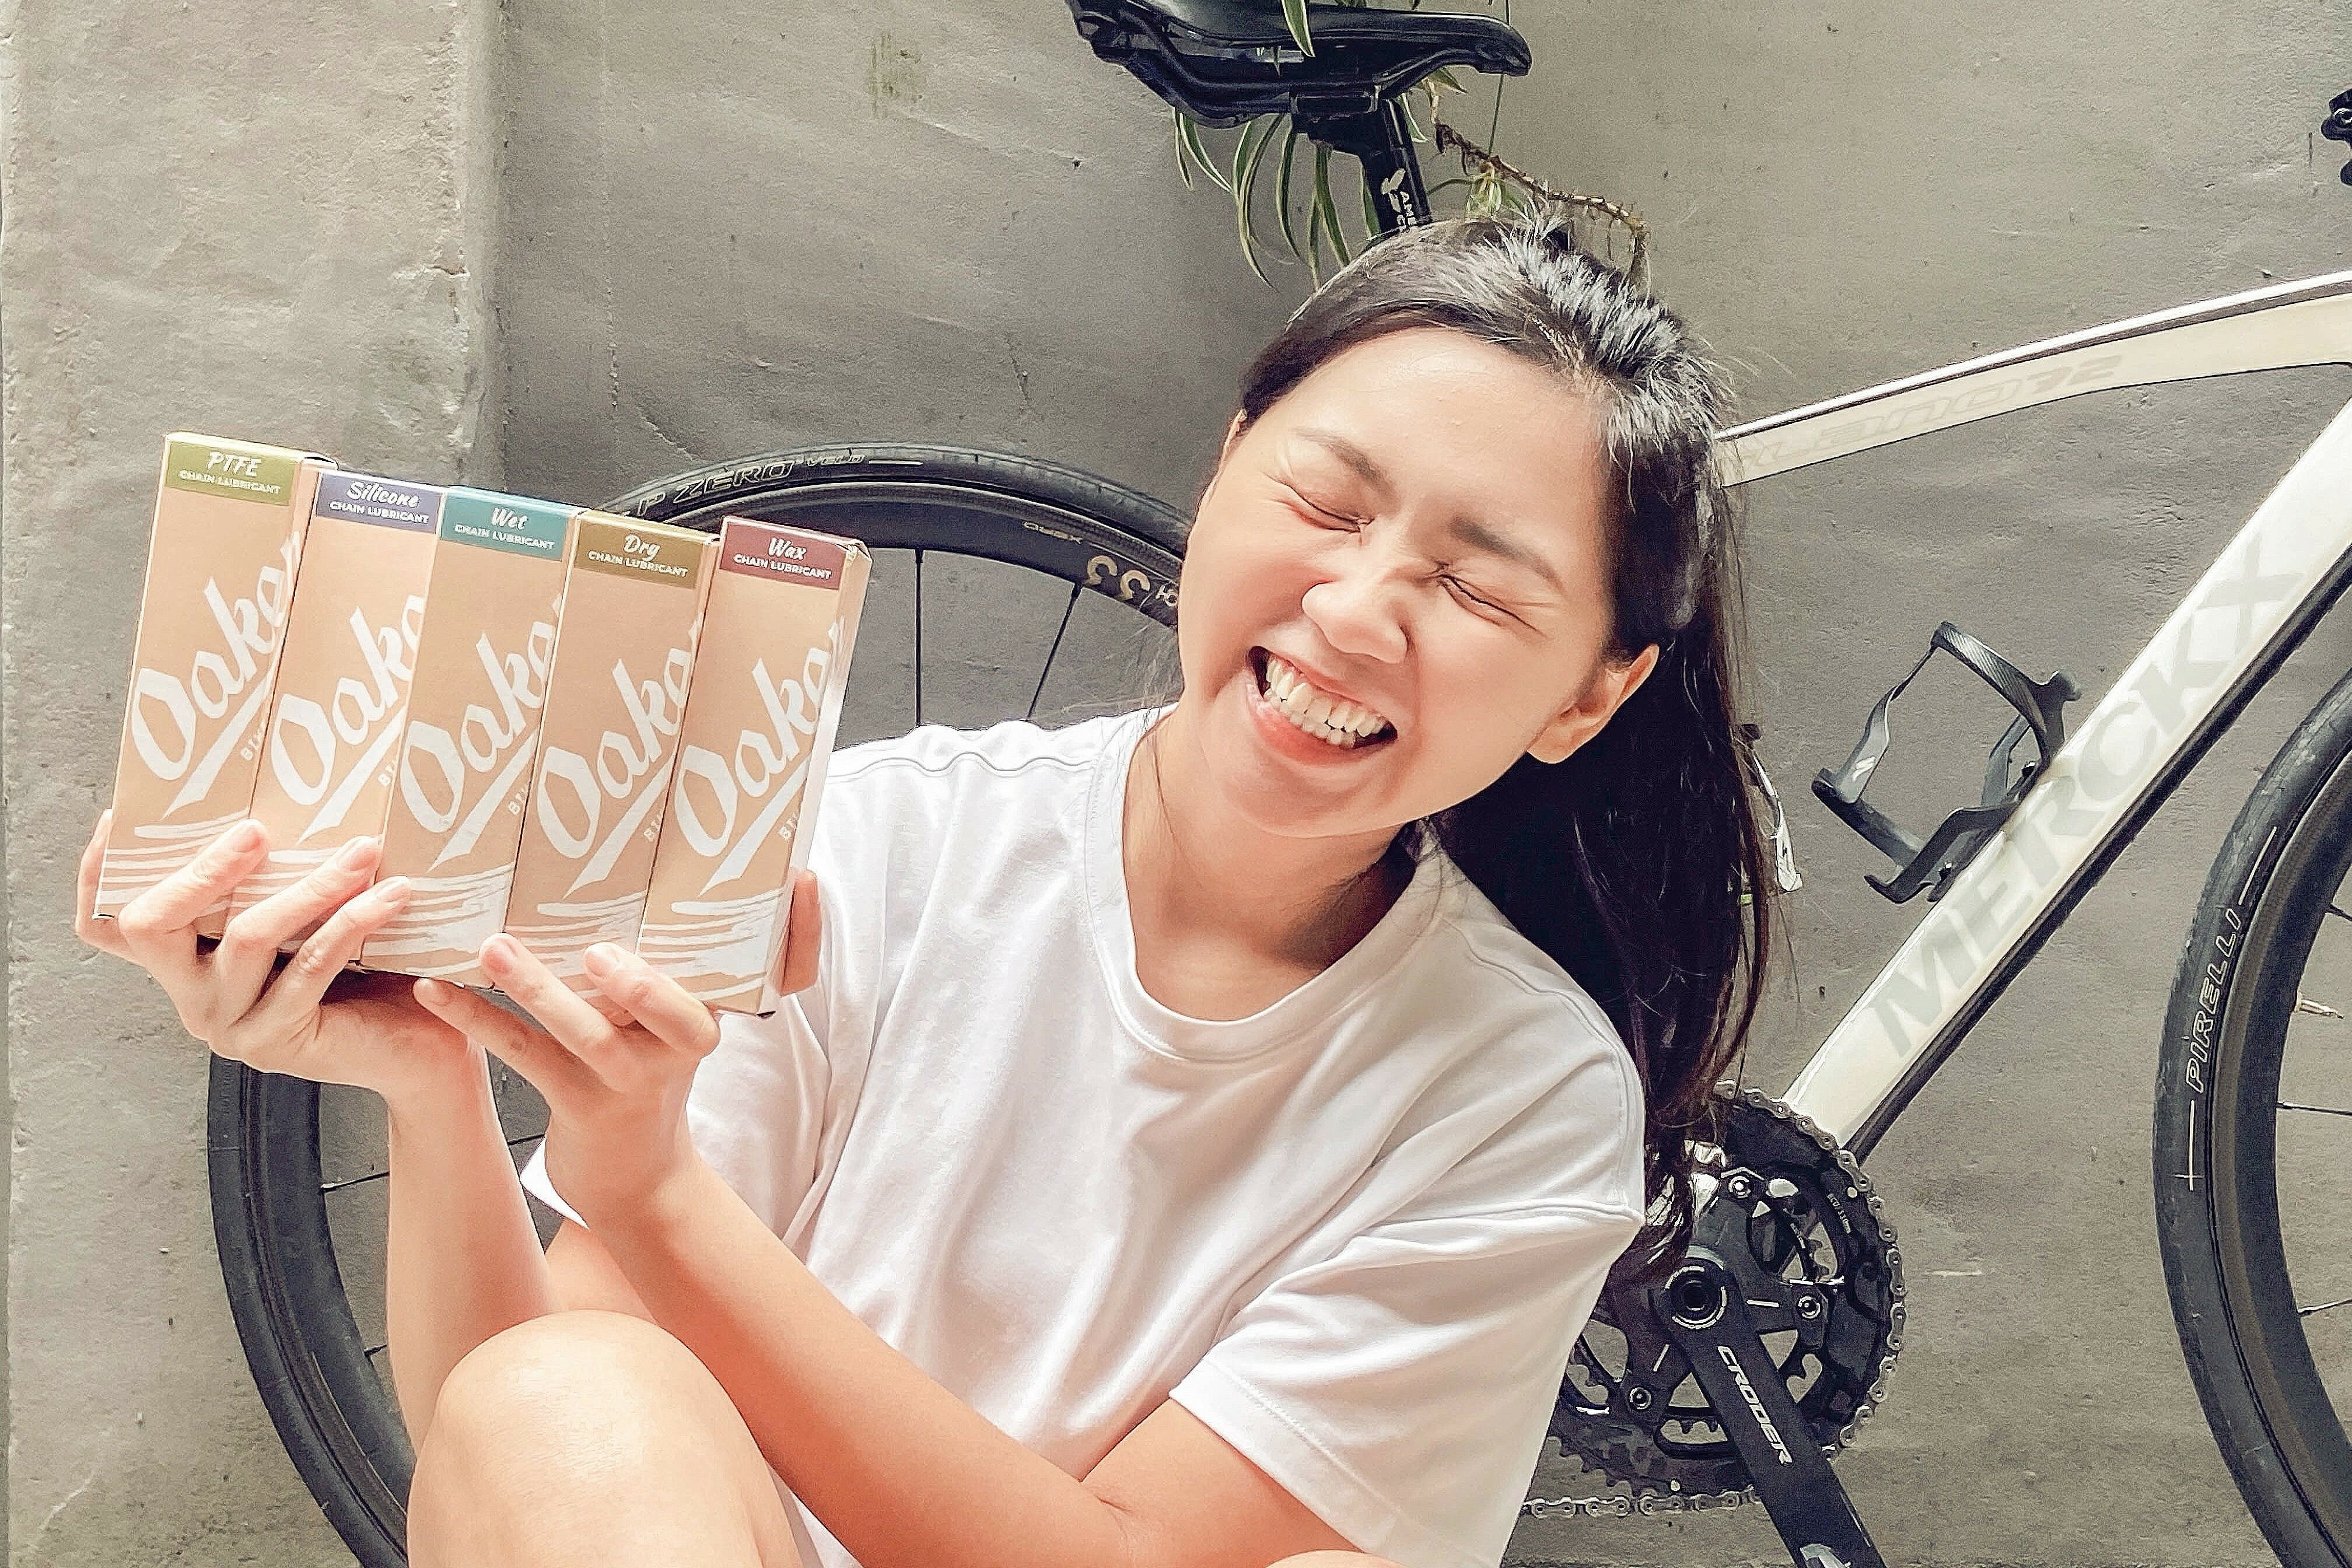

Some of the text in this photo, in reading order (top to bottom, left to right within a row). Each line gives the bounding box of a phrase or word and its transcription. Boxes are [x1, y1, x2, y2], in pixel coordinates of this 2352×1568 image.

[206, 450, 262, 478] PTFE
[179, 469, 281, 495] CHAIN LUBRICANT
[346, 480, 420, 509] Silicone
[636, 492, 665, 517] P
[673, 460, 794, 505] ZERO
[328, 499, 429, 525] CHAIN LUBRICANT
[491, 506, 527, 530] Wet
[454, 524, 555, 551] CHAIN LUBRICANT
[623, 534, 660, 561] Dry
[768, 537, 807, 561] Wax
[588, 550, 688, 578] CHAIN LUBRICANT
[733, 554, 832, 580] CHAIN LUBRICANT
[1869, 536, 2304, 1059] MERCKX
[2185, 908, 2242, 1094] PIRELLI
[1717, 1346, 1793, 1465] CRODER
